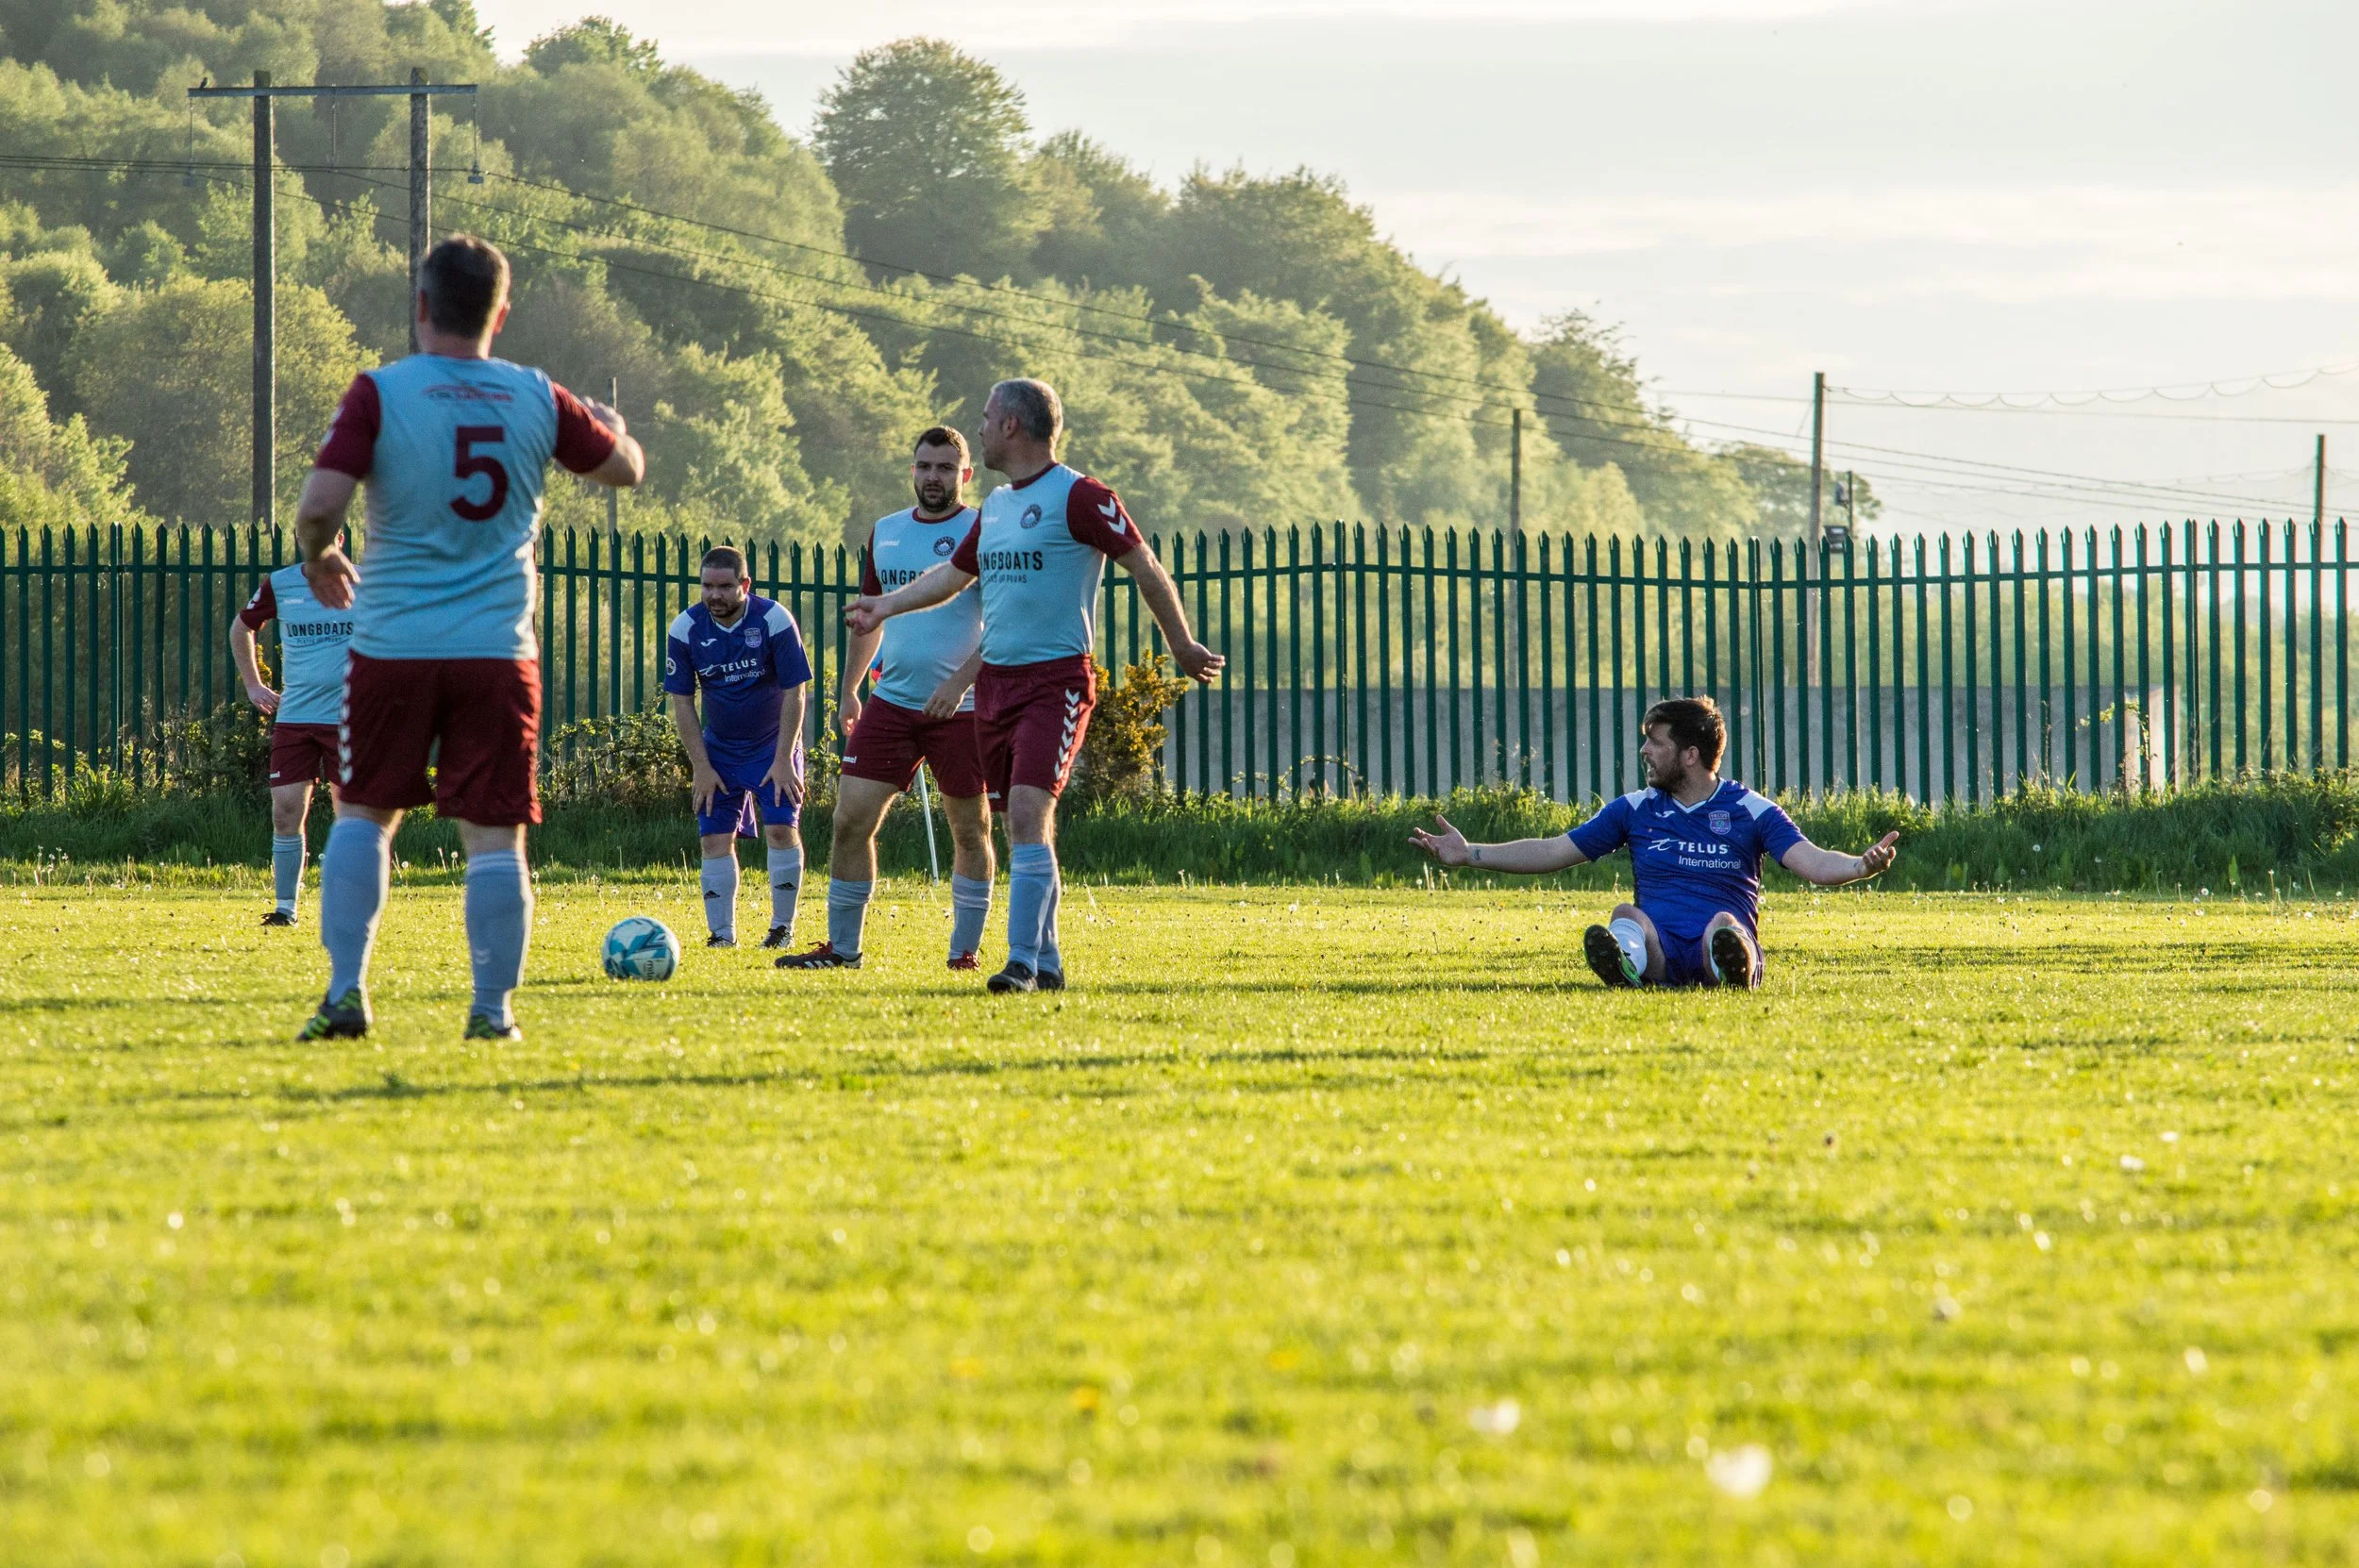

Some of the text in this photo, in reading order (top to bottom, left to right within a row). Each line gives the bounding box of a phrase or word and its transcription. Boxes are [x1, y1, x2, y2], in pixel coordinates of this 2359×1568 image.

[449, 425, 508, 521] 5
[287, 623, 354, 637] LONGBOATS
[720, 658, 758, 673] TELUS
[1678, 841, 1729, 854] TELUS
[1678, 855, 1741, 869] International
